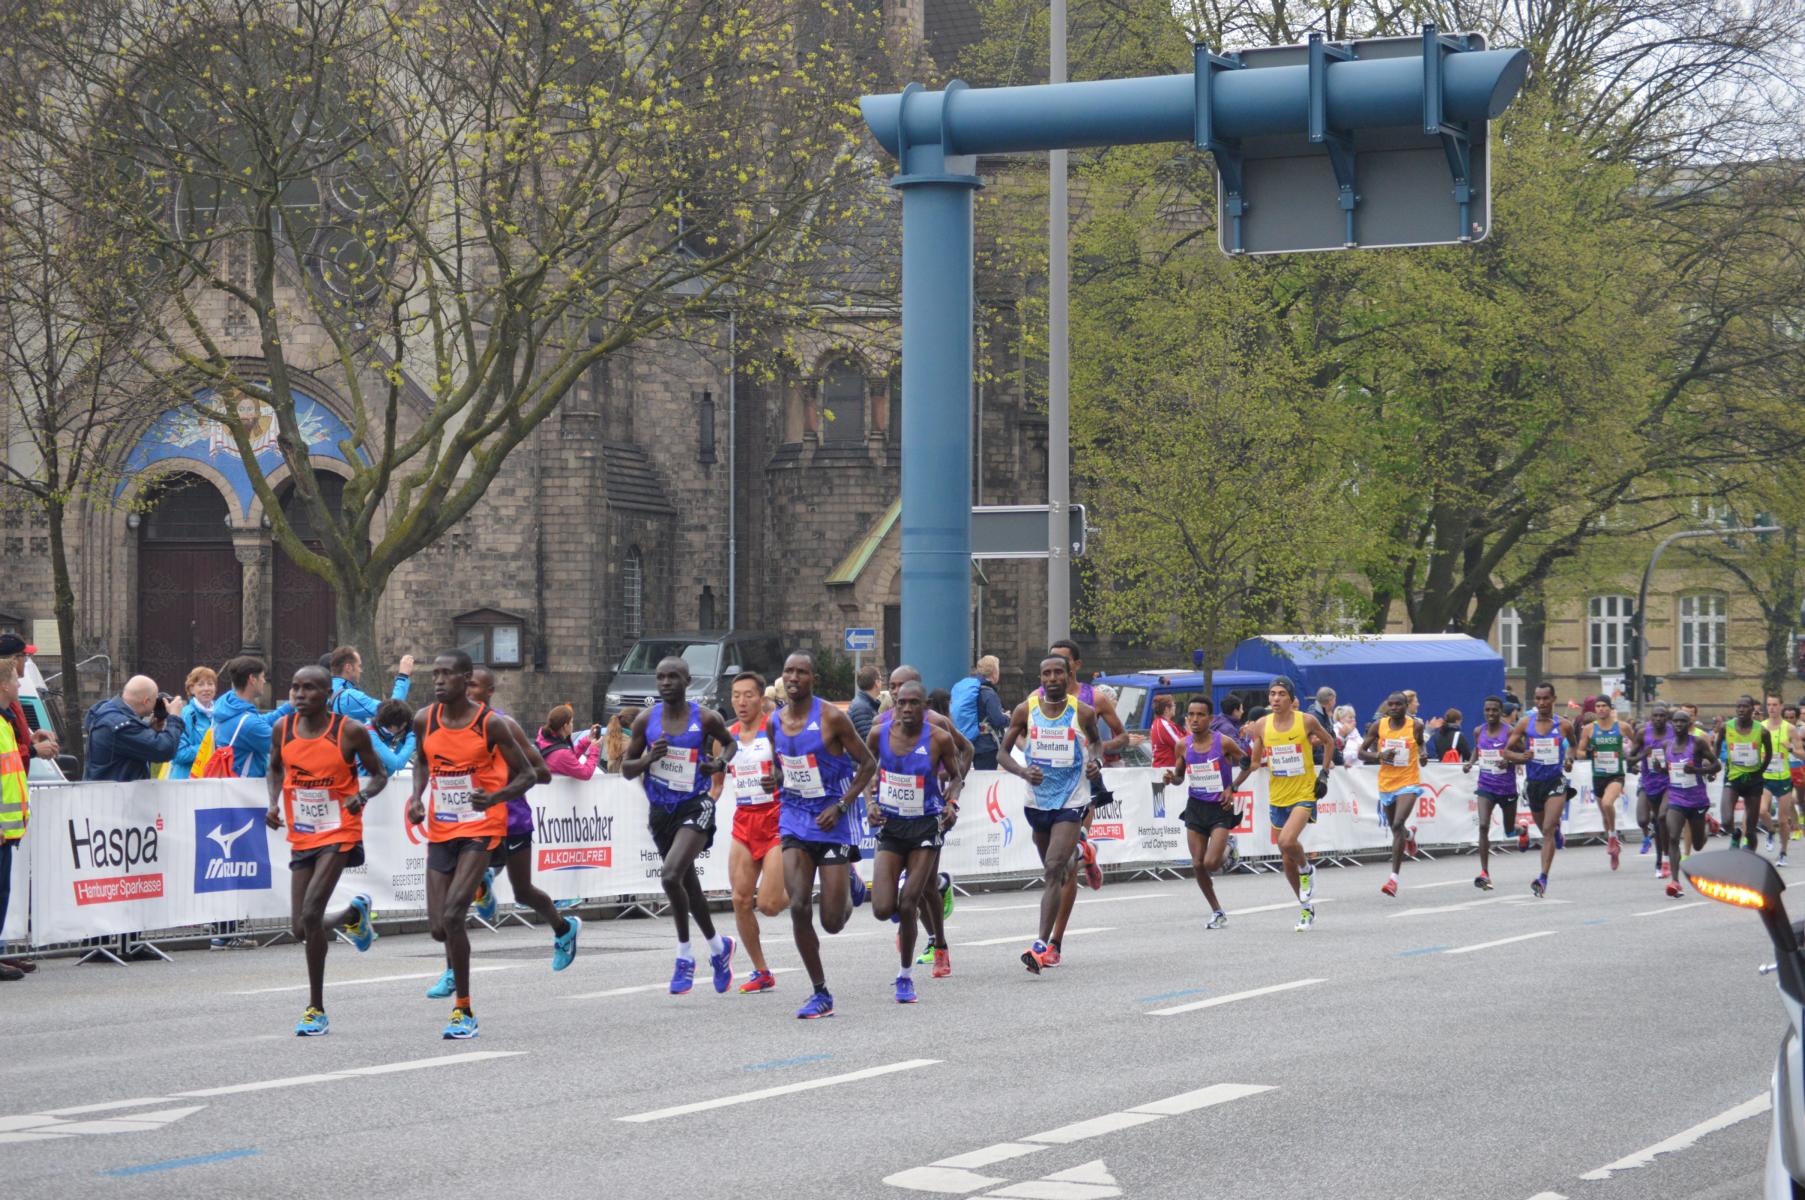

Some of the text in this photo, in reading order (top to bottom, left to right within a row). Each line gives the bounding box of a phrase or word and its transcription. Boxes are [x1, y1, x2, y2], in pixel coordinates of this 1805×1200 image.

[1036, 741, 1068, 751] Shentama
[660, 760, 683, 773] Rotich
[787, 770, 811, 782] PACE5
[887, 787, 915, 801] PACE3
[300, 803, 328, 817] PACE1
[1416, 798, 1435, 818] BS
[536, 805, 613, 844] Krombacher
[1089, 826, 1121, 837] OHOLFREI
[1138, 826, 1163, 837] Hamburg
[69, 818, 158, 873] Haspa
[1142, 839, 1177, 850] und Congress
[544, 849, 607, 864] ALKOHOLFREI
[406, 858, 424, 870] SPORT
[392, 874, 424, 886] BEGEISTERT
[77, 879, 161, 900] Hamburger Sparkasse
[395, 890, 424, 902] HAMBURG
